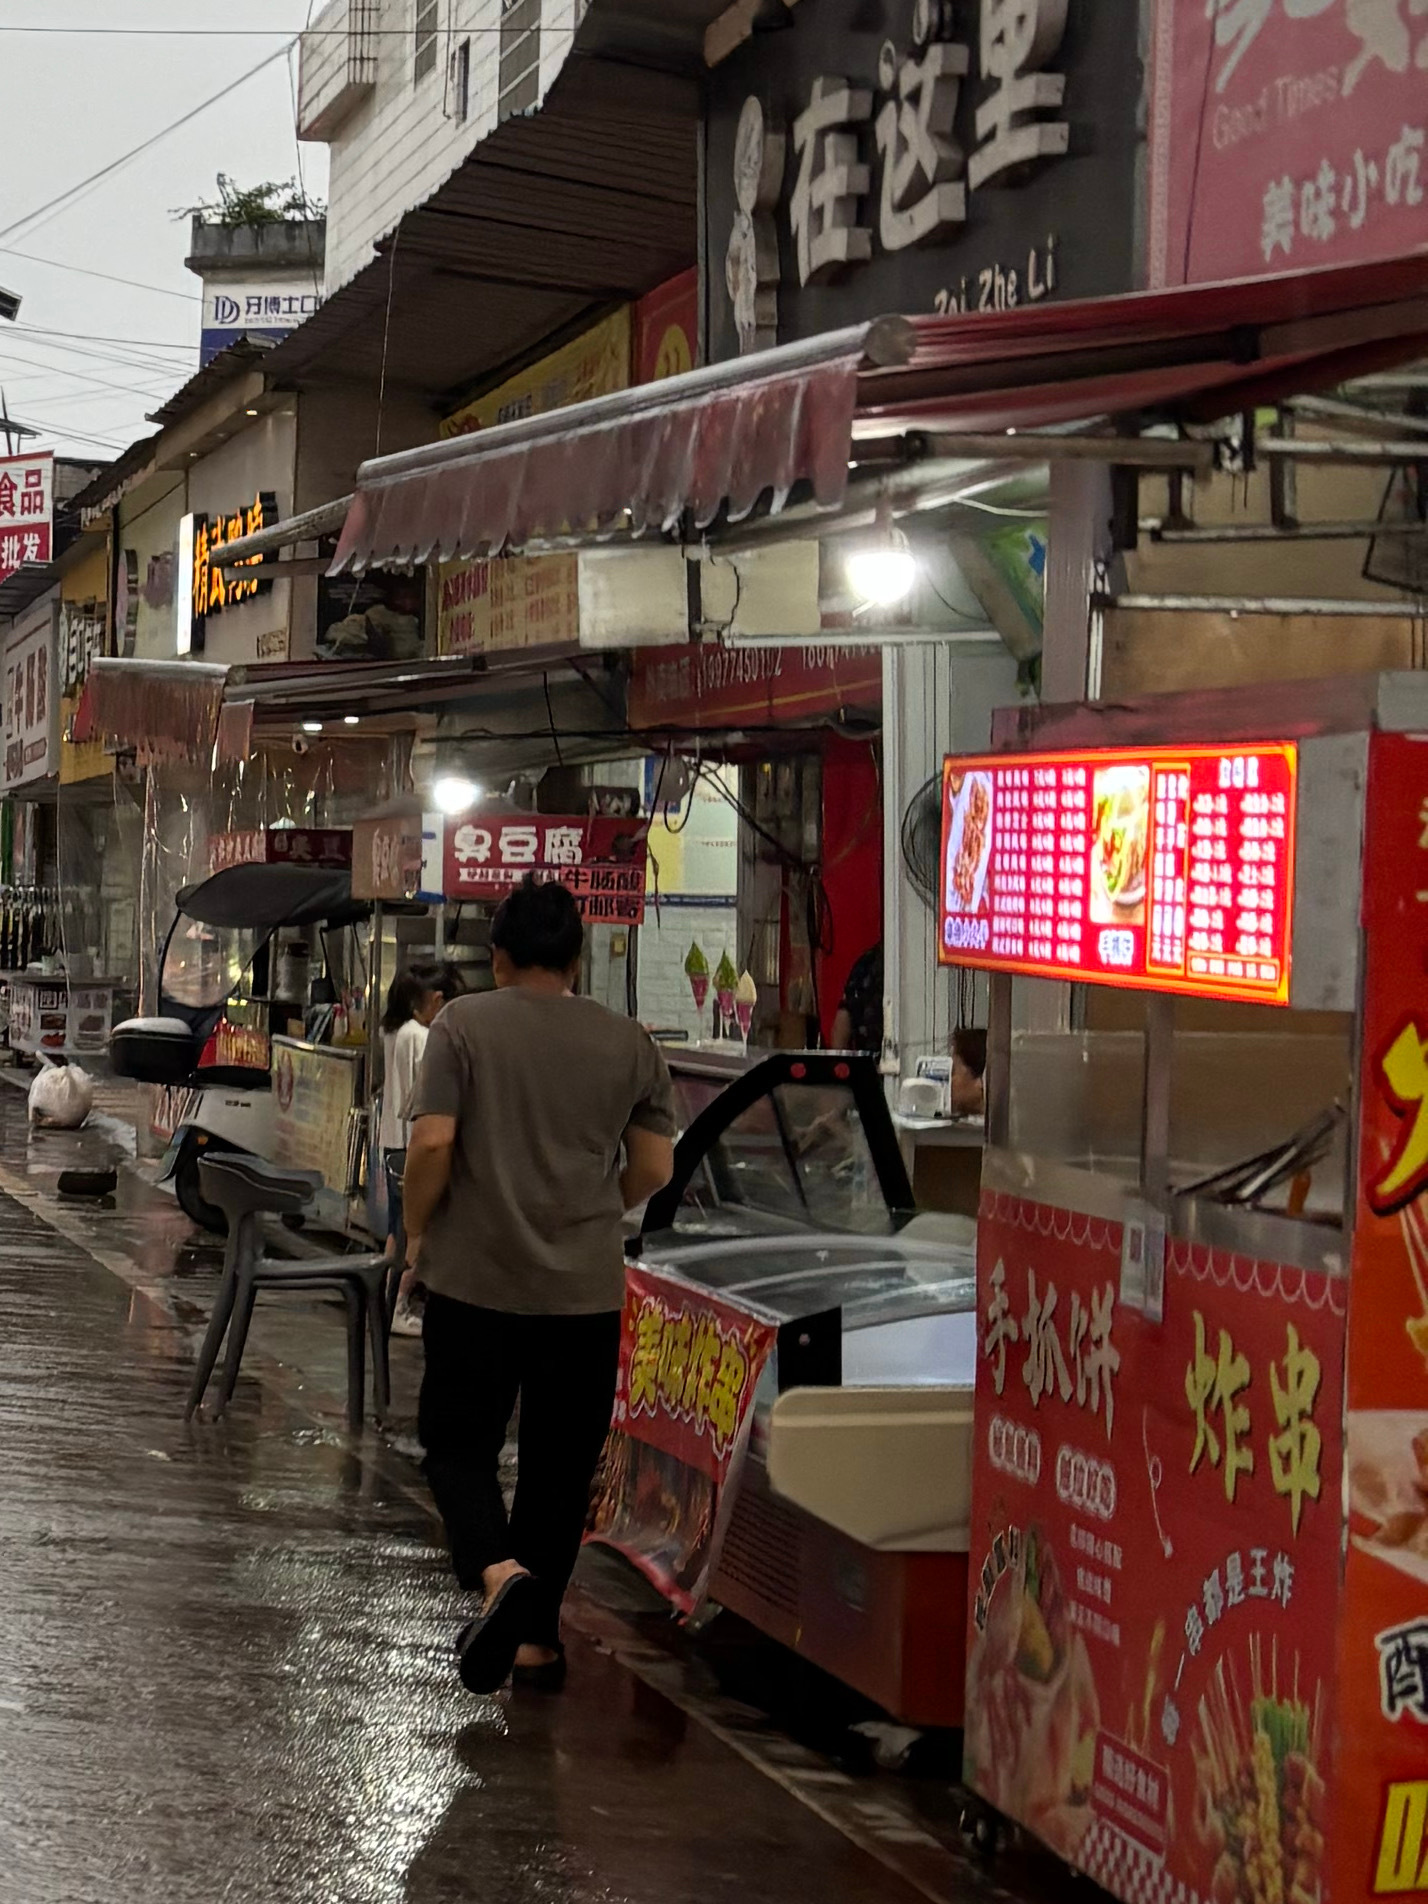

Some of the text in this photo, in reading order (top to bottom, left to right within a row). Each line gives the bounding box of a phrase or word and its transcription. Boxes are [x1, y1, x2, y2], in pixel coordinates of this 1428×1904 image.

[1260, 123, 1425, 263] 美味小吃
[979, 265, 1017, 311] Zhe
[1028, 234, 1055, 297] Li
[454, 824, 584, 865] 臭豆腐
[984, 1255, 1121, 1443] 手抓饼
[1185, 1309, 1324, 1537] 炸串
